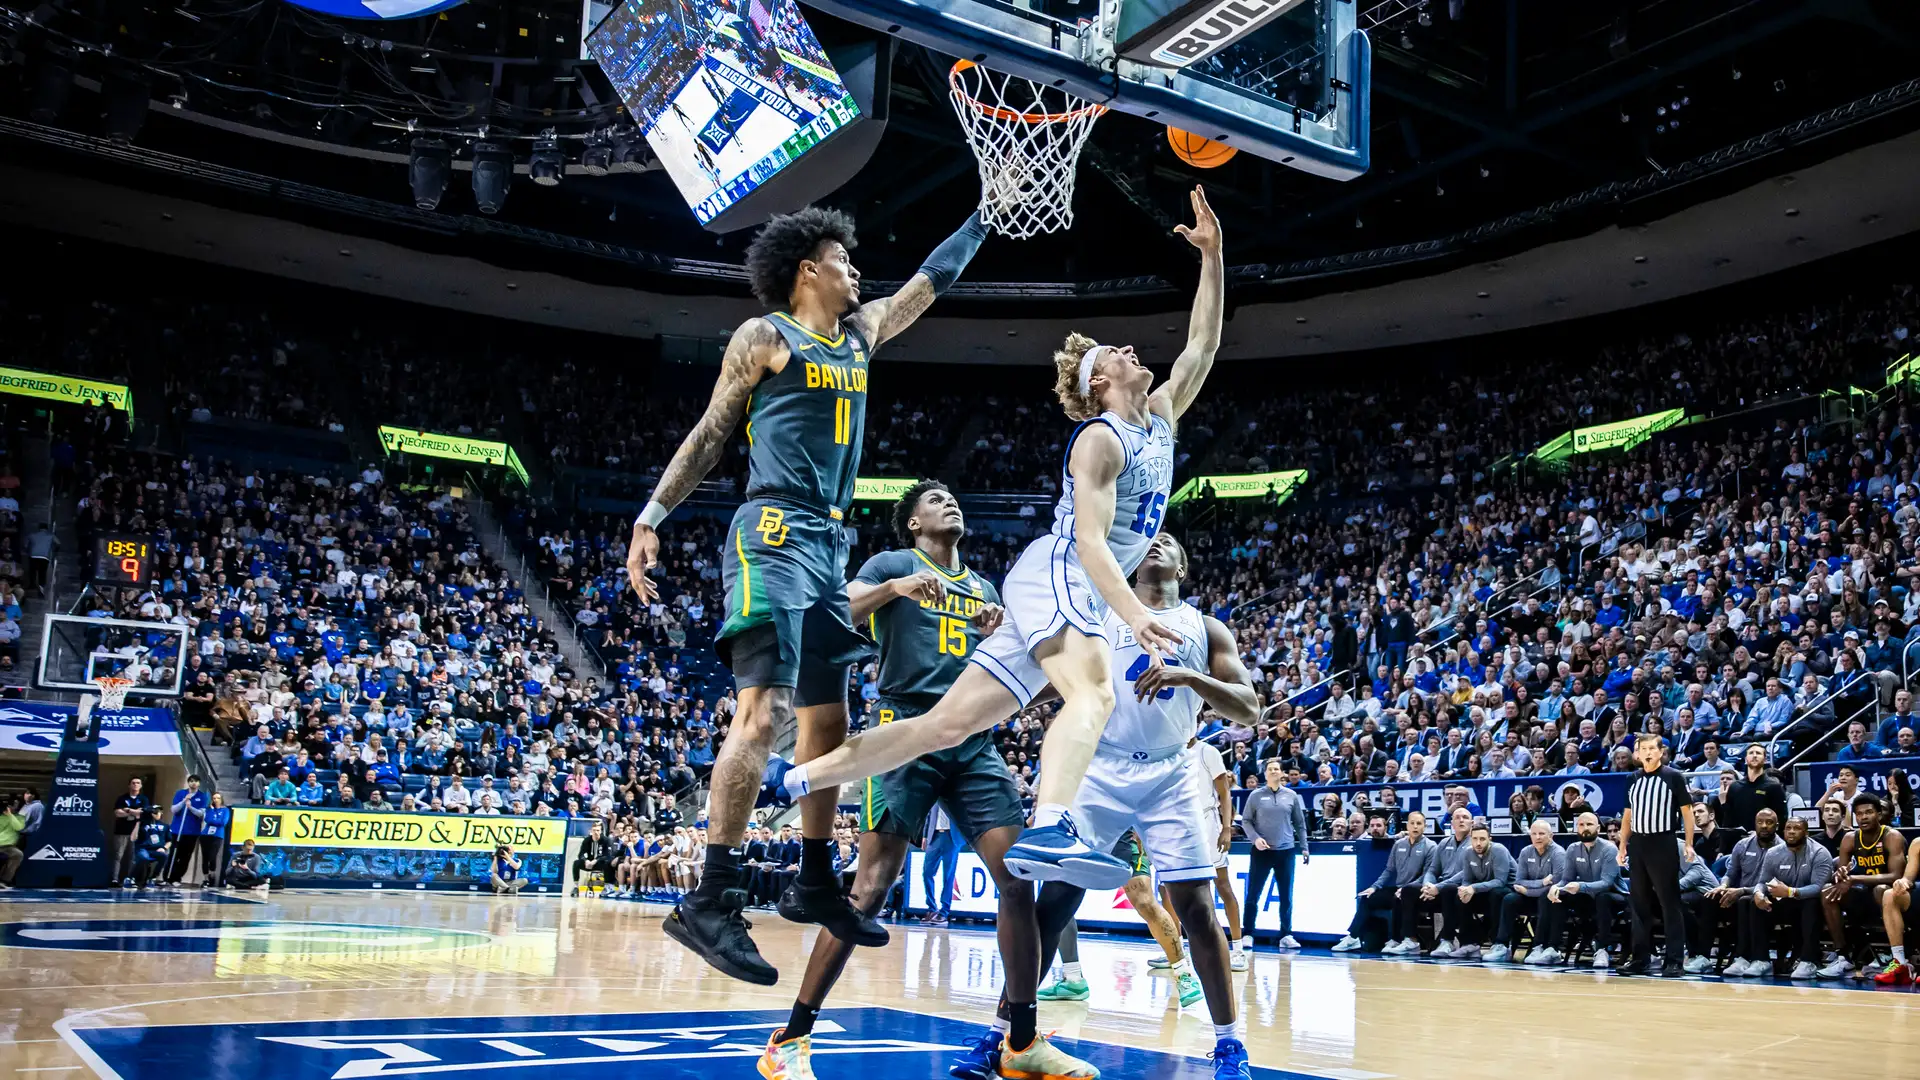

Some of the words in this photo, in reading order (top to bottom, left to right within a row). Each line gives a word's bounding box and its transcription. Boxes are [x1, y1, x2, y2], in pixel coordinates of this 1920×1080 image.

[716, 63, 762, 95] BRIGHAM
[760, 89, 803, 120] YOUNG
[816, 116, 832, 136] 16
[716, 193, 726, 208] 8
[60, 383, 73, 396] &
[834, 397, 851, 446] 11
[399, 434, 451, 452] SIEGFRIED
[452, 444, 462, 454] &
[464, 443, 504, 458] JENSEN
[870, 484, 880, 494] &
[1215, 481, 1260, 491] SIEGFRIED
[756, 506, 790, 547] BU
[1130, 491, 1166, 539] 15
[107, 541, 147, 557] 13:51
[121, 558, 140, 582] 9
[939, 616, 967, 656] 15
[1115, 624, 1196, 661] BU
[294, 813, 423, 842] SIEGFRIED
[428, 820, 453, 844] &
[457, 820, 545, 846] JENSEN
